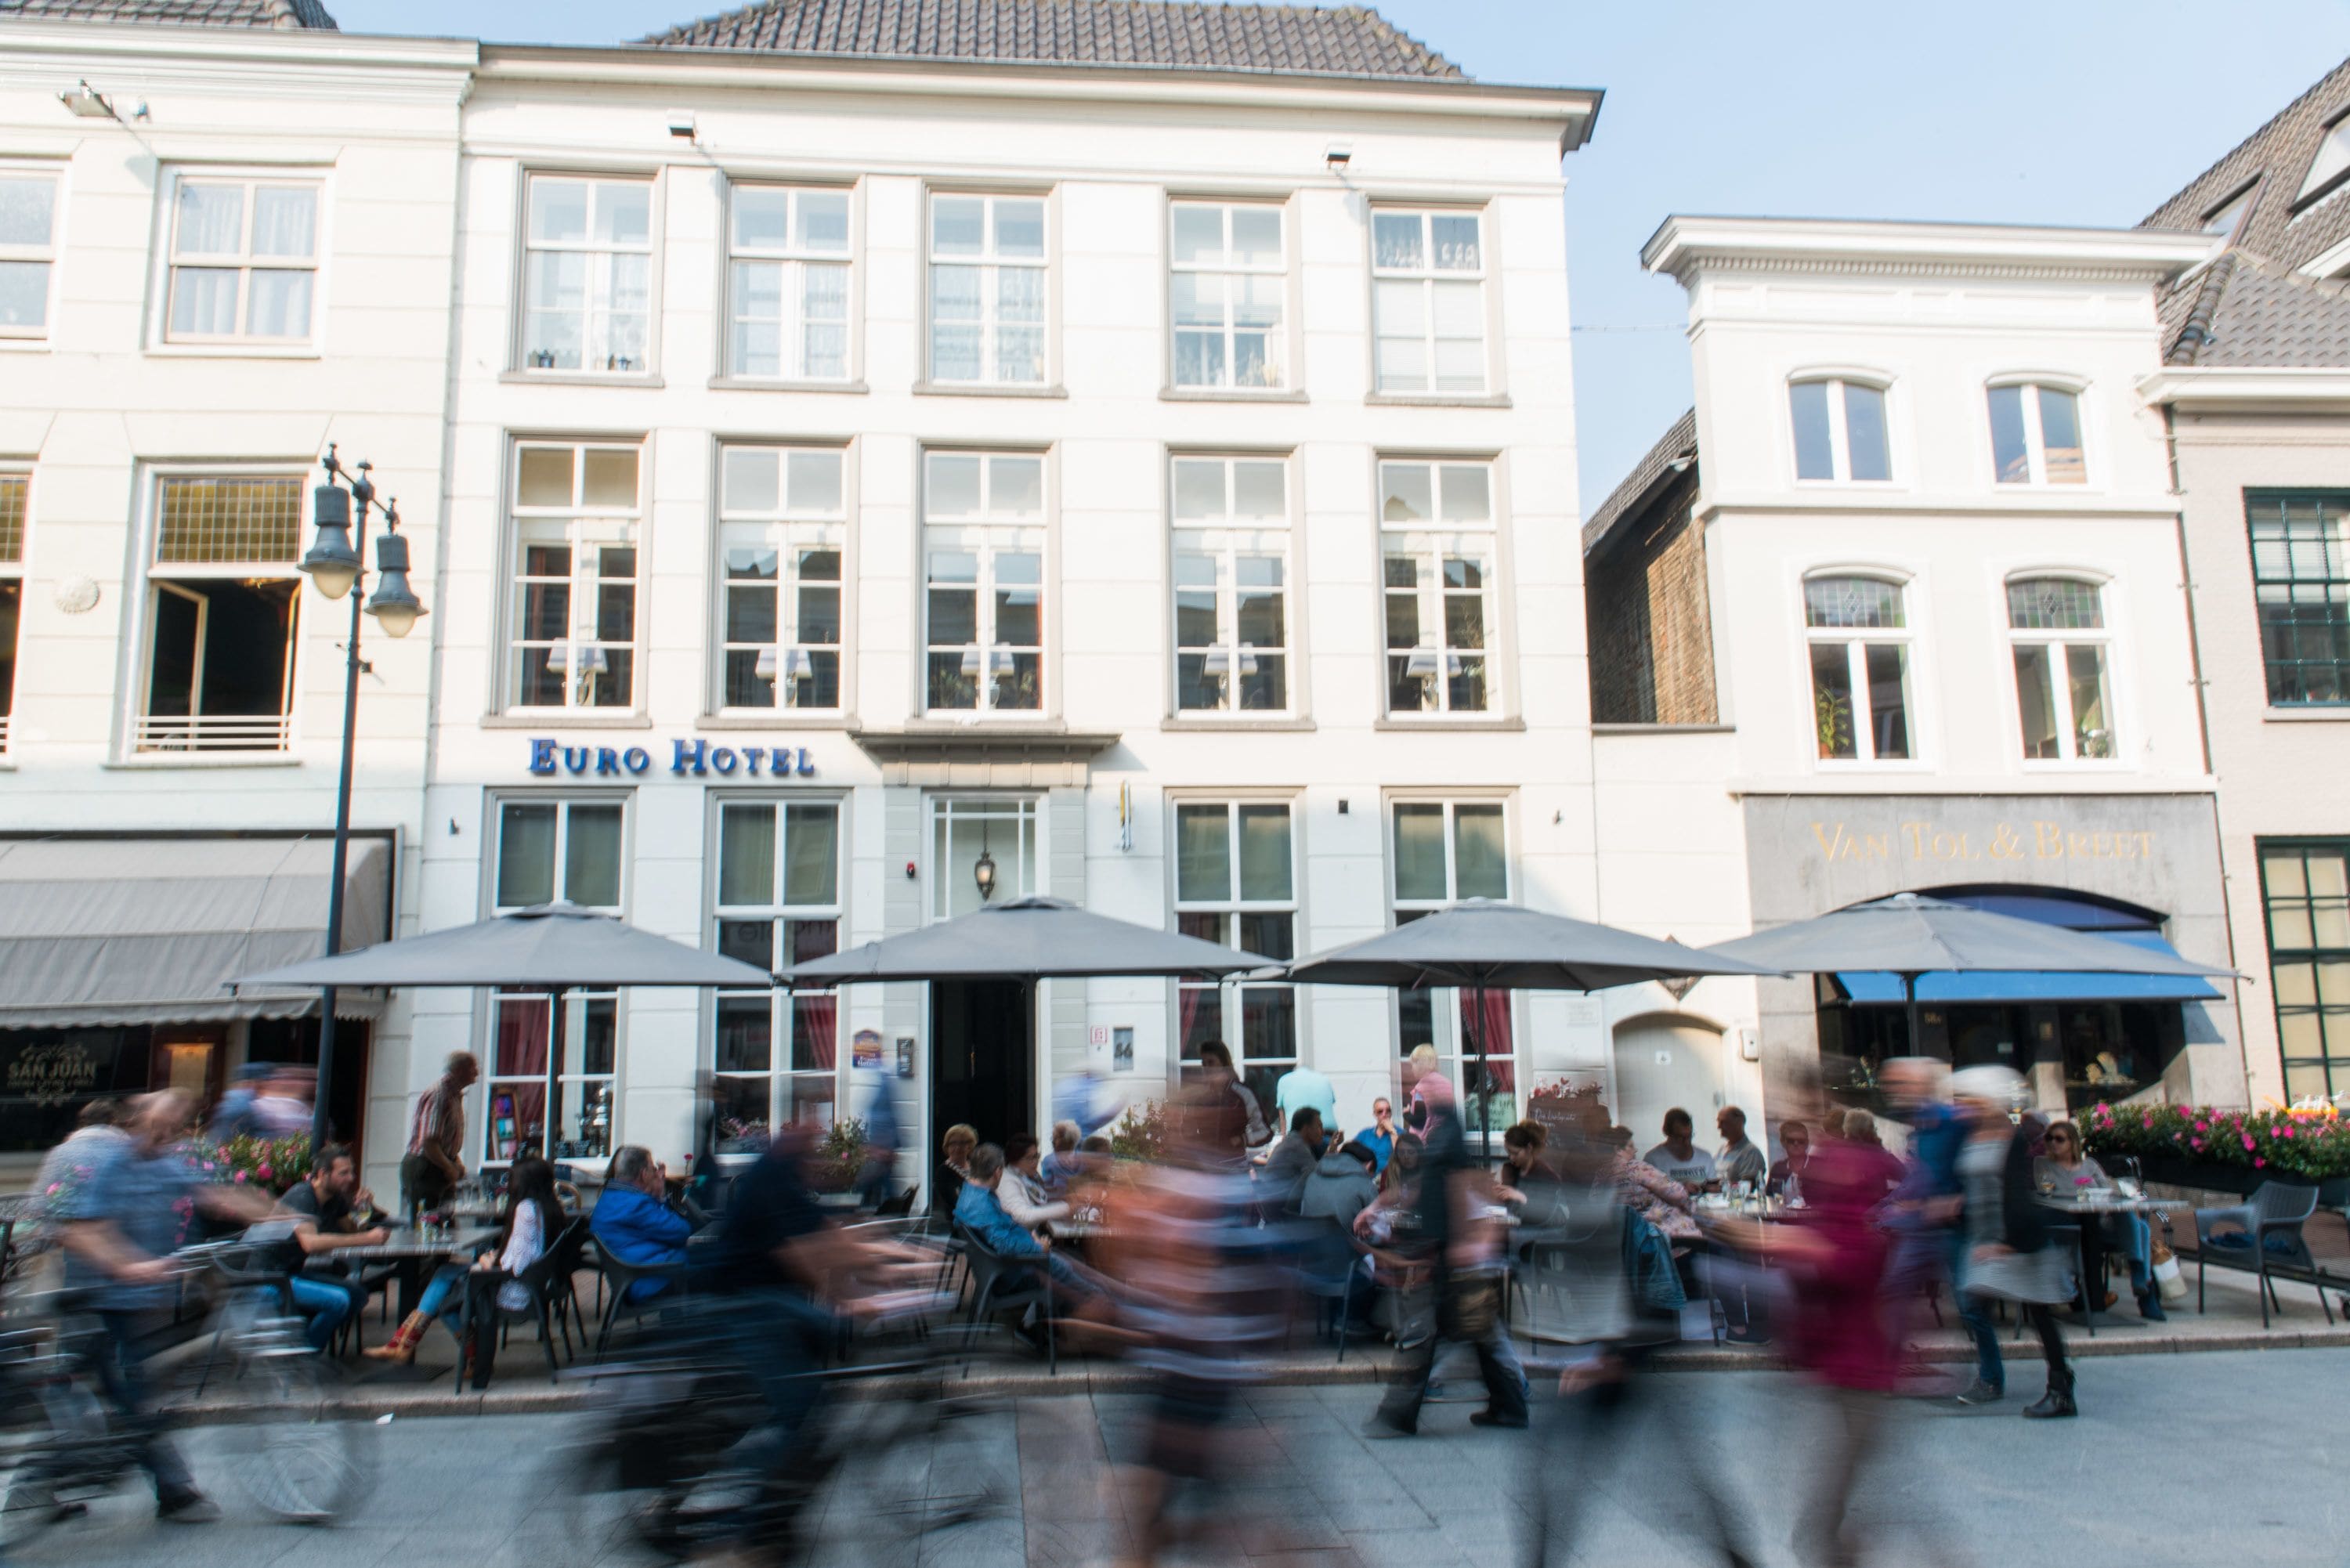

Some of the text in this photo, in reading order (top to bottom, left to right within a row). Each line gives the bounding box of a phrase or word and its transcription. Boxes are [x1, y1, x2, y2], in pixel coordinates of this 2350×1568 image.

[529, 738, 815, 775] EURO HOTEL
[1811, 822, 1889, 862] VAN
[1902, 821, 1980, 862] TOL
[1988, 821, 2025, 861] &
[8, 1060, 98, 1078] SAN JUAN
